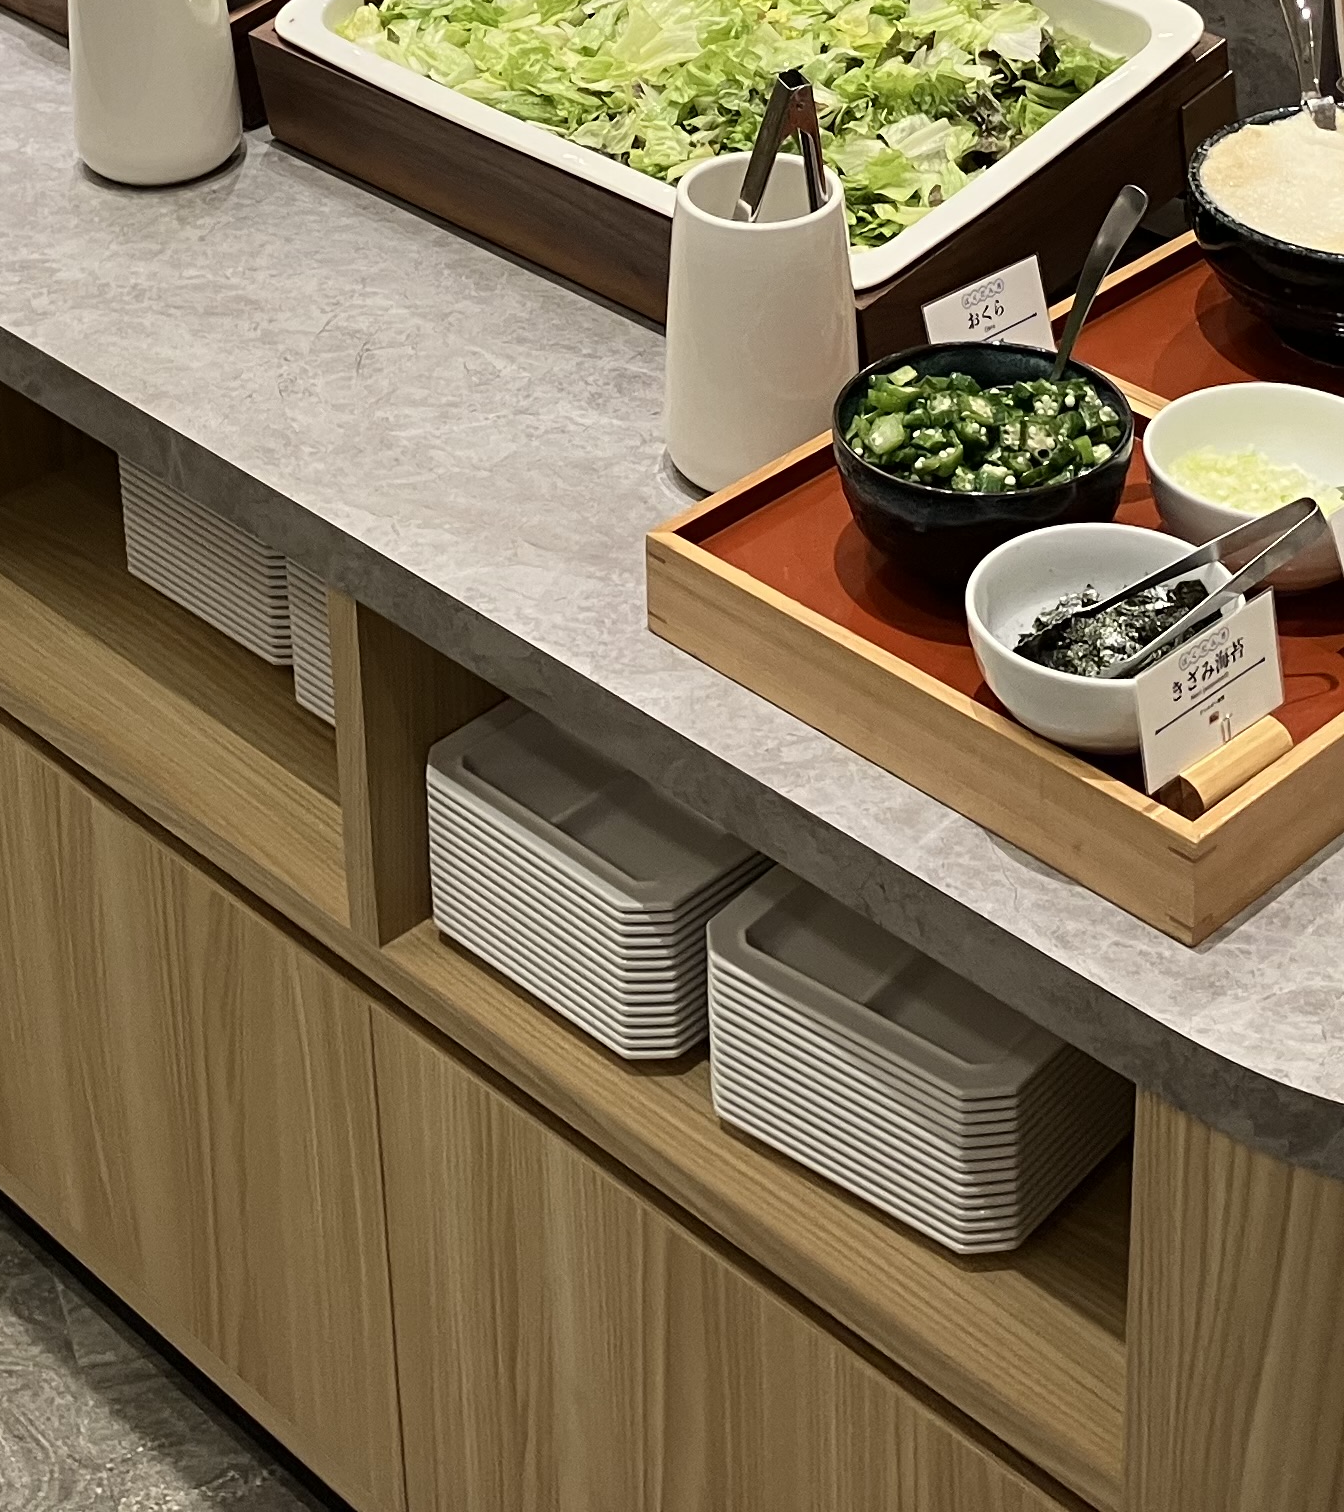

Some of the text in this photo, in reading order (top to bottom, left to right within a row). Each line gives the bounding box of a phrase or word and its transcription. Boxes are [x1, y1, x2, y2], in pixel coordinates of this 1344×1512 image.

[967, 299, 1005, 330] おくら
[1171, 636, 1244, 702] きざみ海苔
